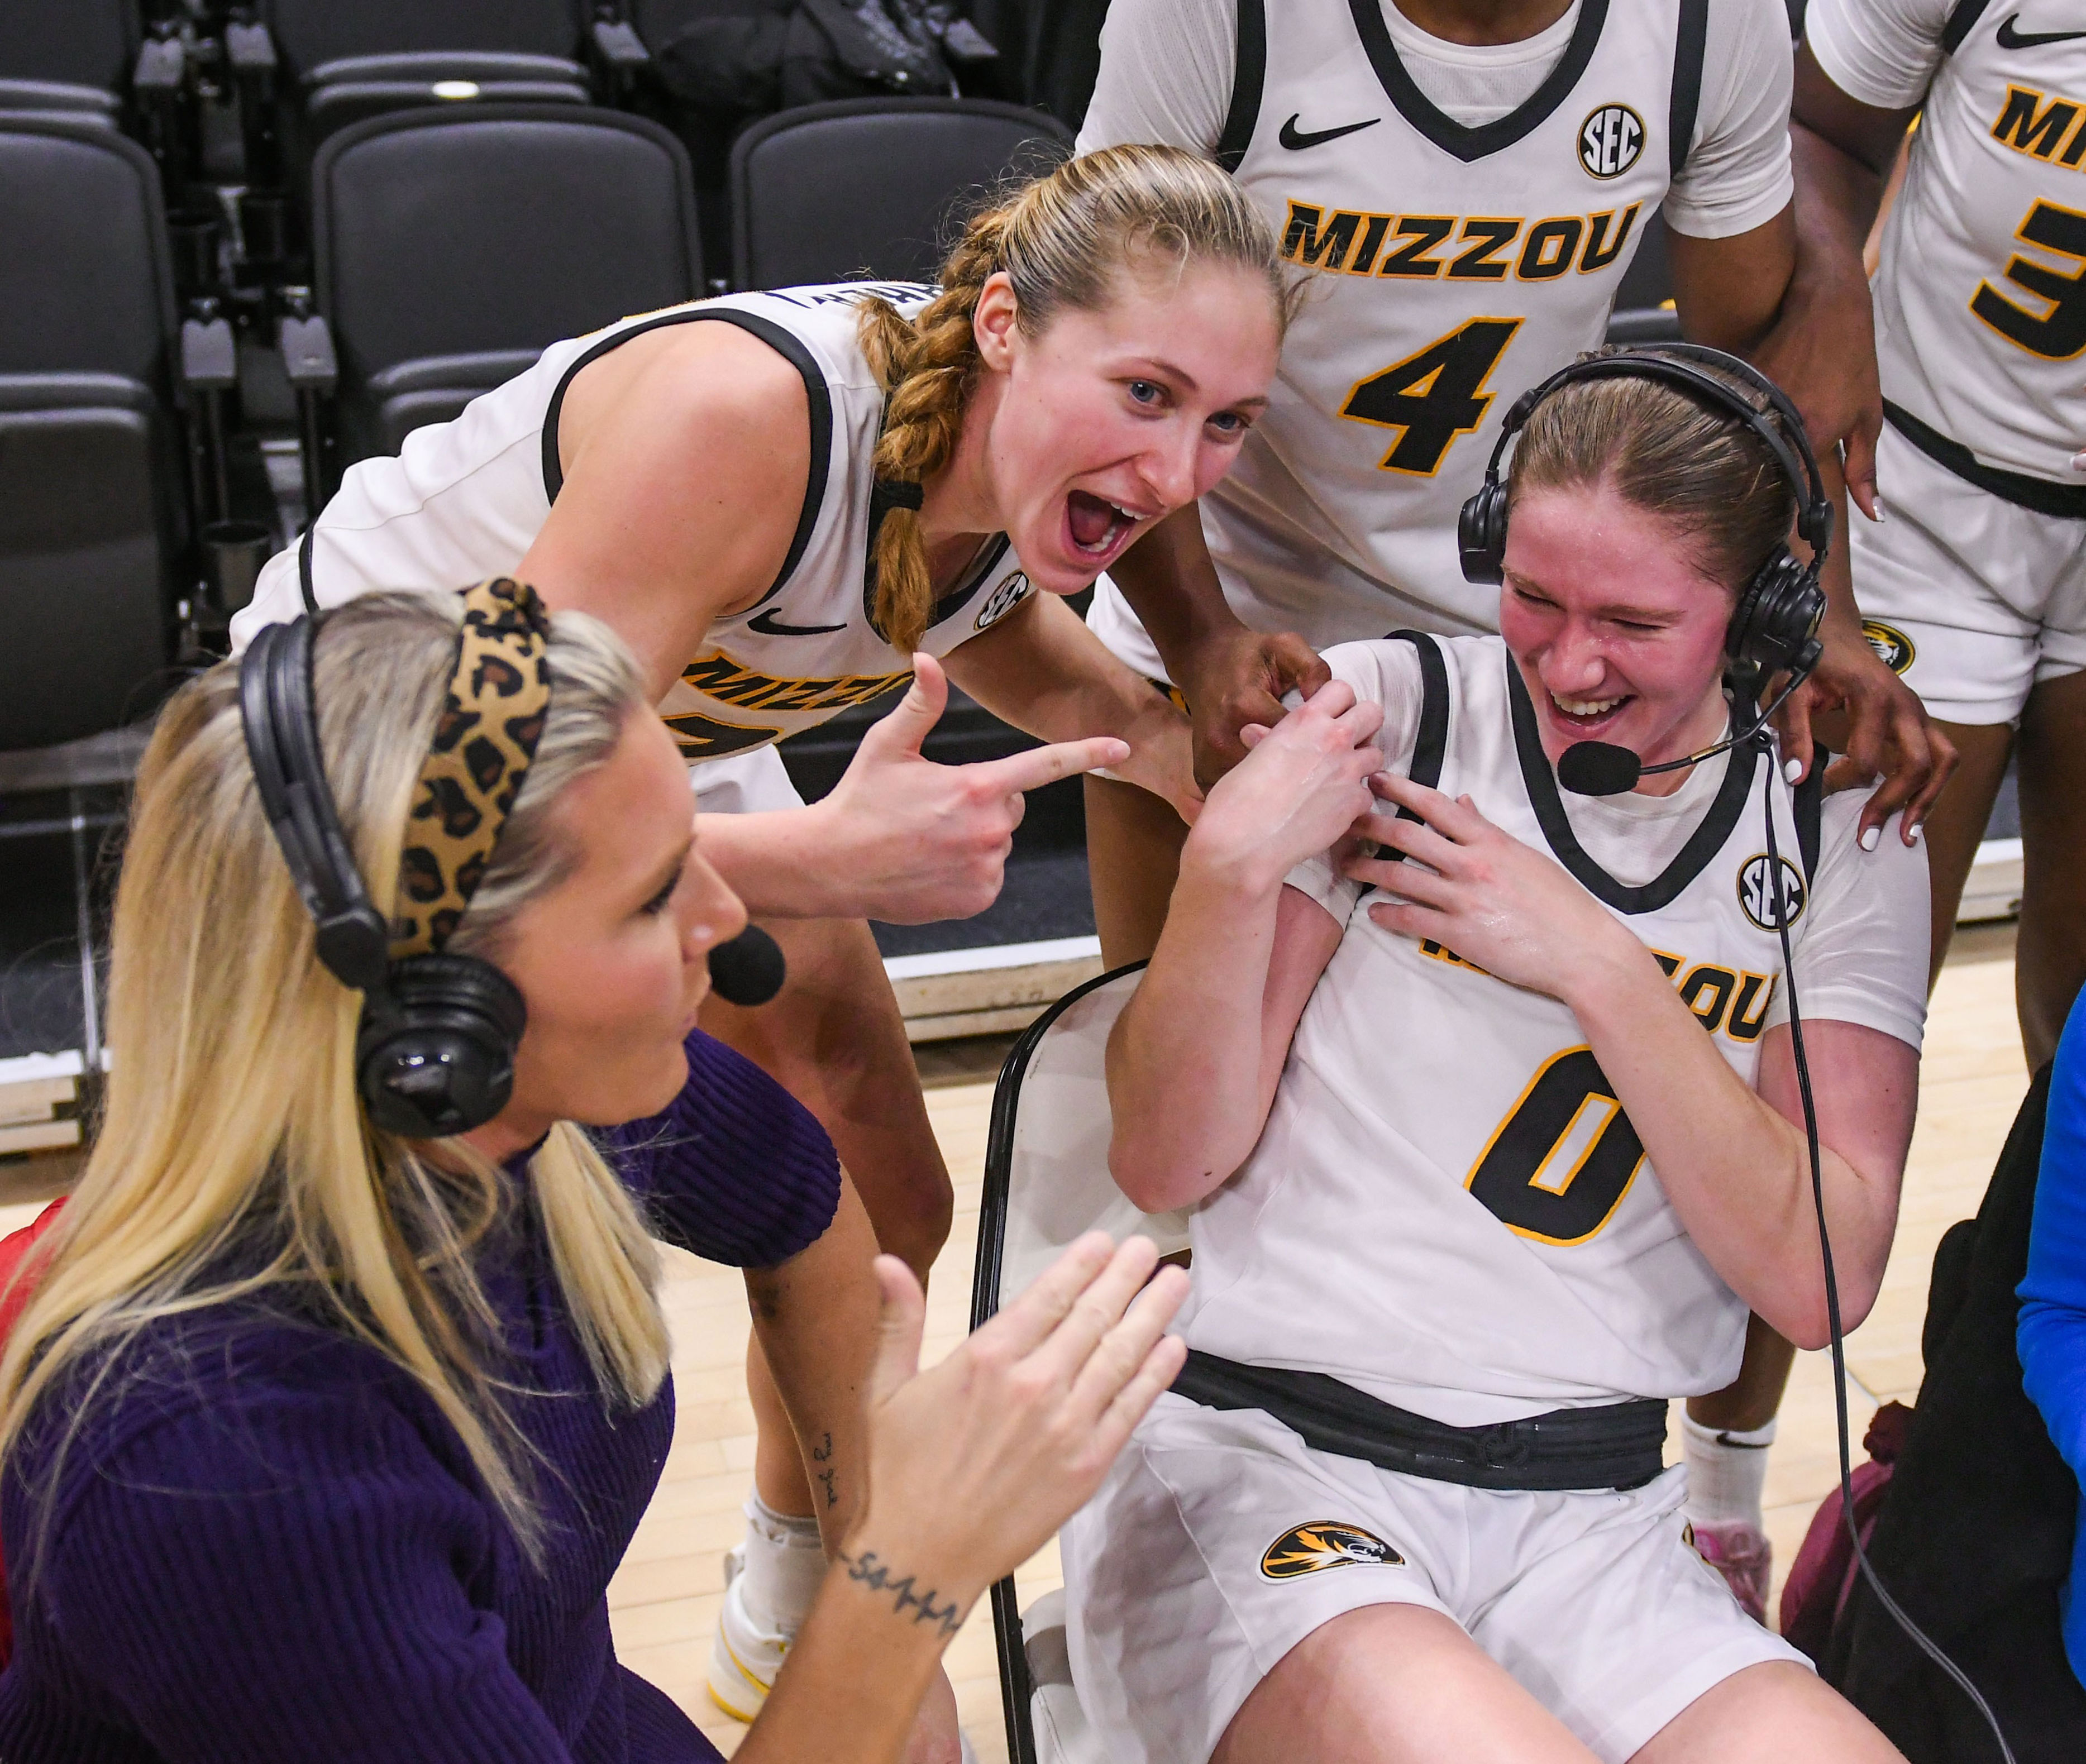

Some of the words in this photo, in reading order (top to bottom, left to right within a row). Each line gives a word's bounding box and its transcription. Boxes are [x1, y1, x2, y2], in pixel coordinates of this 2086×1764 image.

[1583, 109, 1643, 174] SEC
[1990, 83, 2086, 173] MI
[1280, 198, 1643, 282] MIZZOU
[1337, 317, 1525, 477] 4
[681, 649, 915, 713] MIZZ
[1742, 858, 1799, 928] SEC
